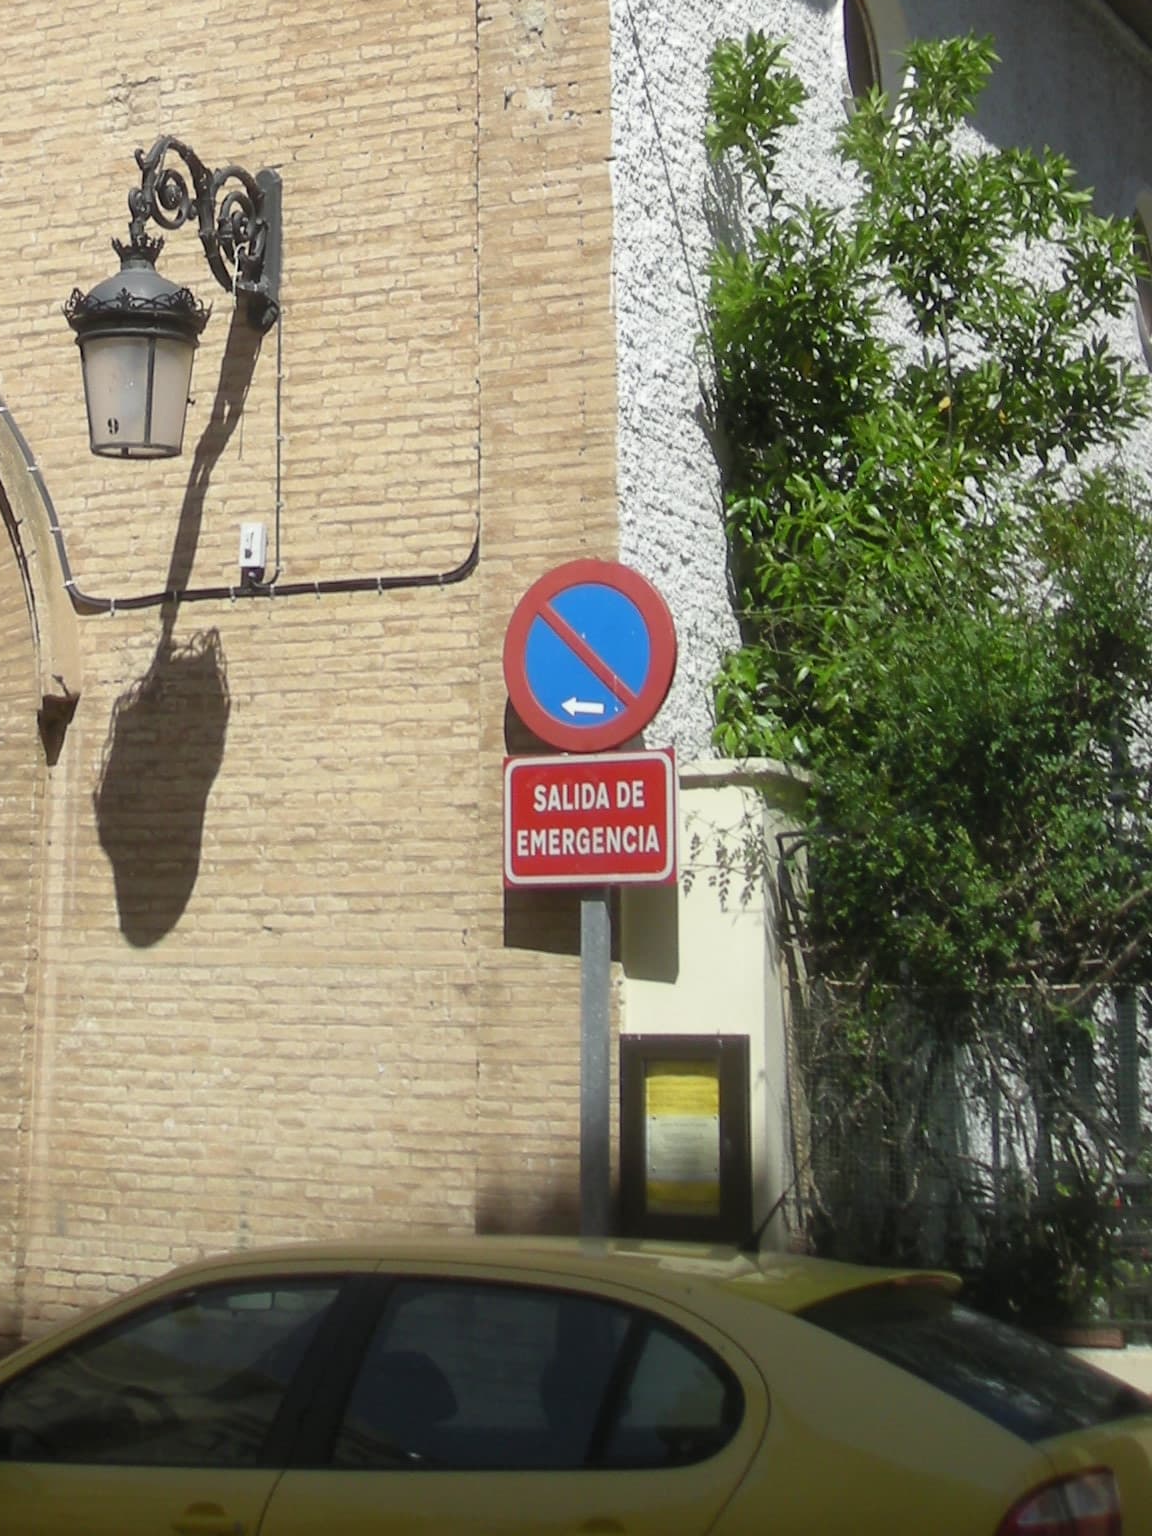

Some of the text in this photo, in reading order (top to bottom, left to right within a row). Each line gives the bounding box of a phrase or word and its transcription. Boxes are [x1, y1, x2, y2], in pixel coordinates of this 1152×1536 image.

[533, 780, 645, 813] SALIDA DE
[516, 825, 660, 857] EMERGENCIA
